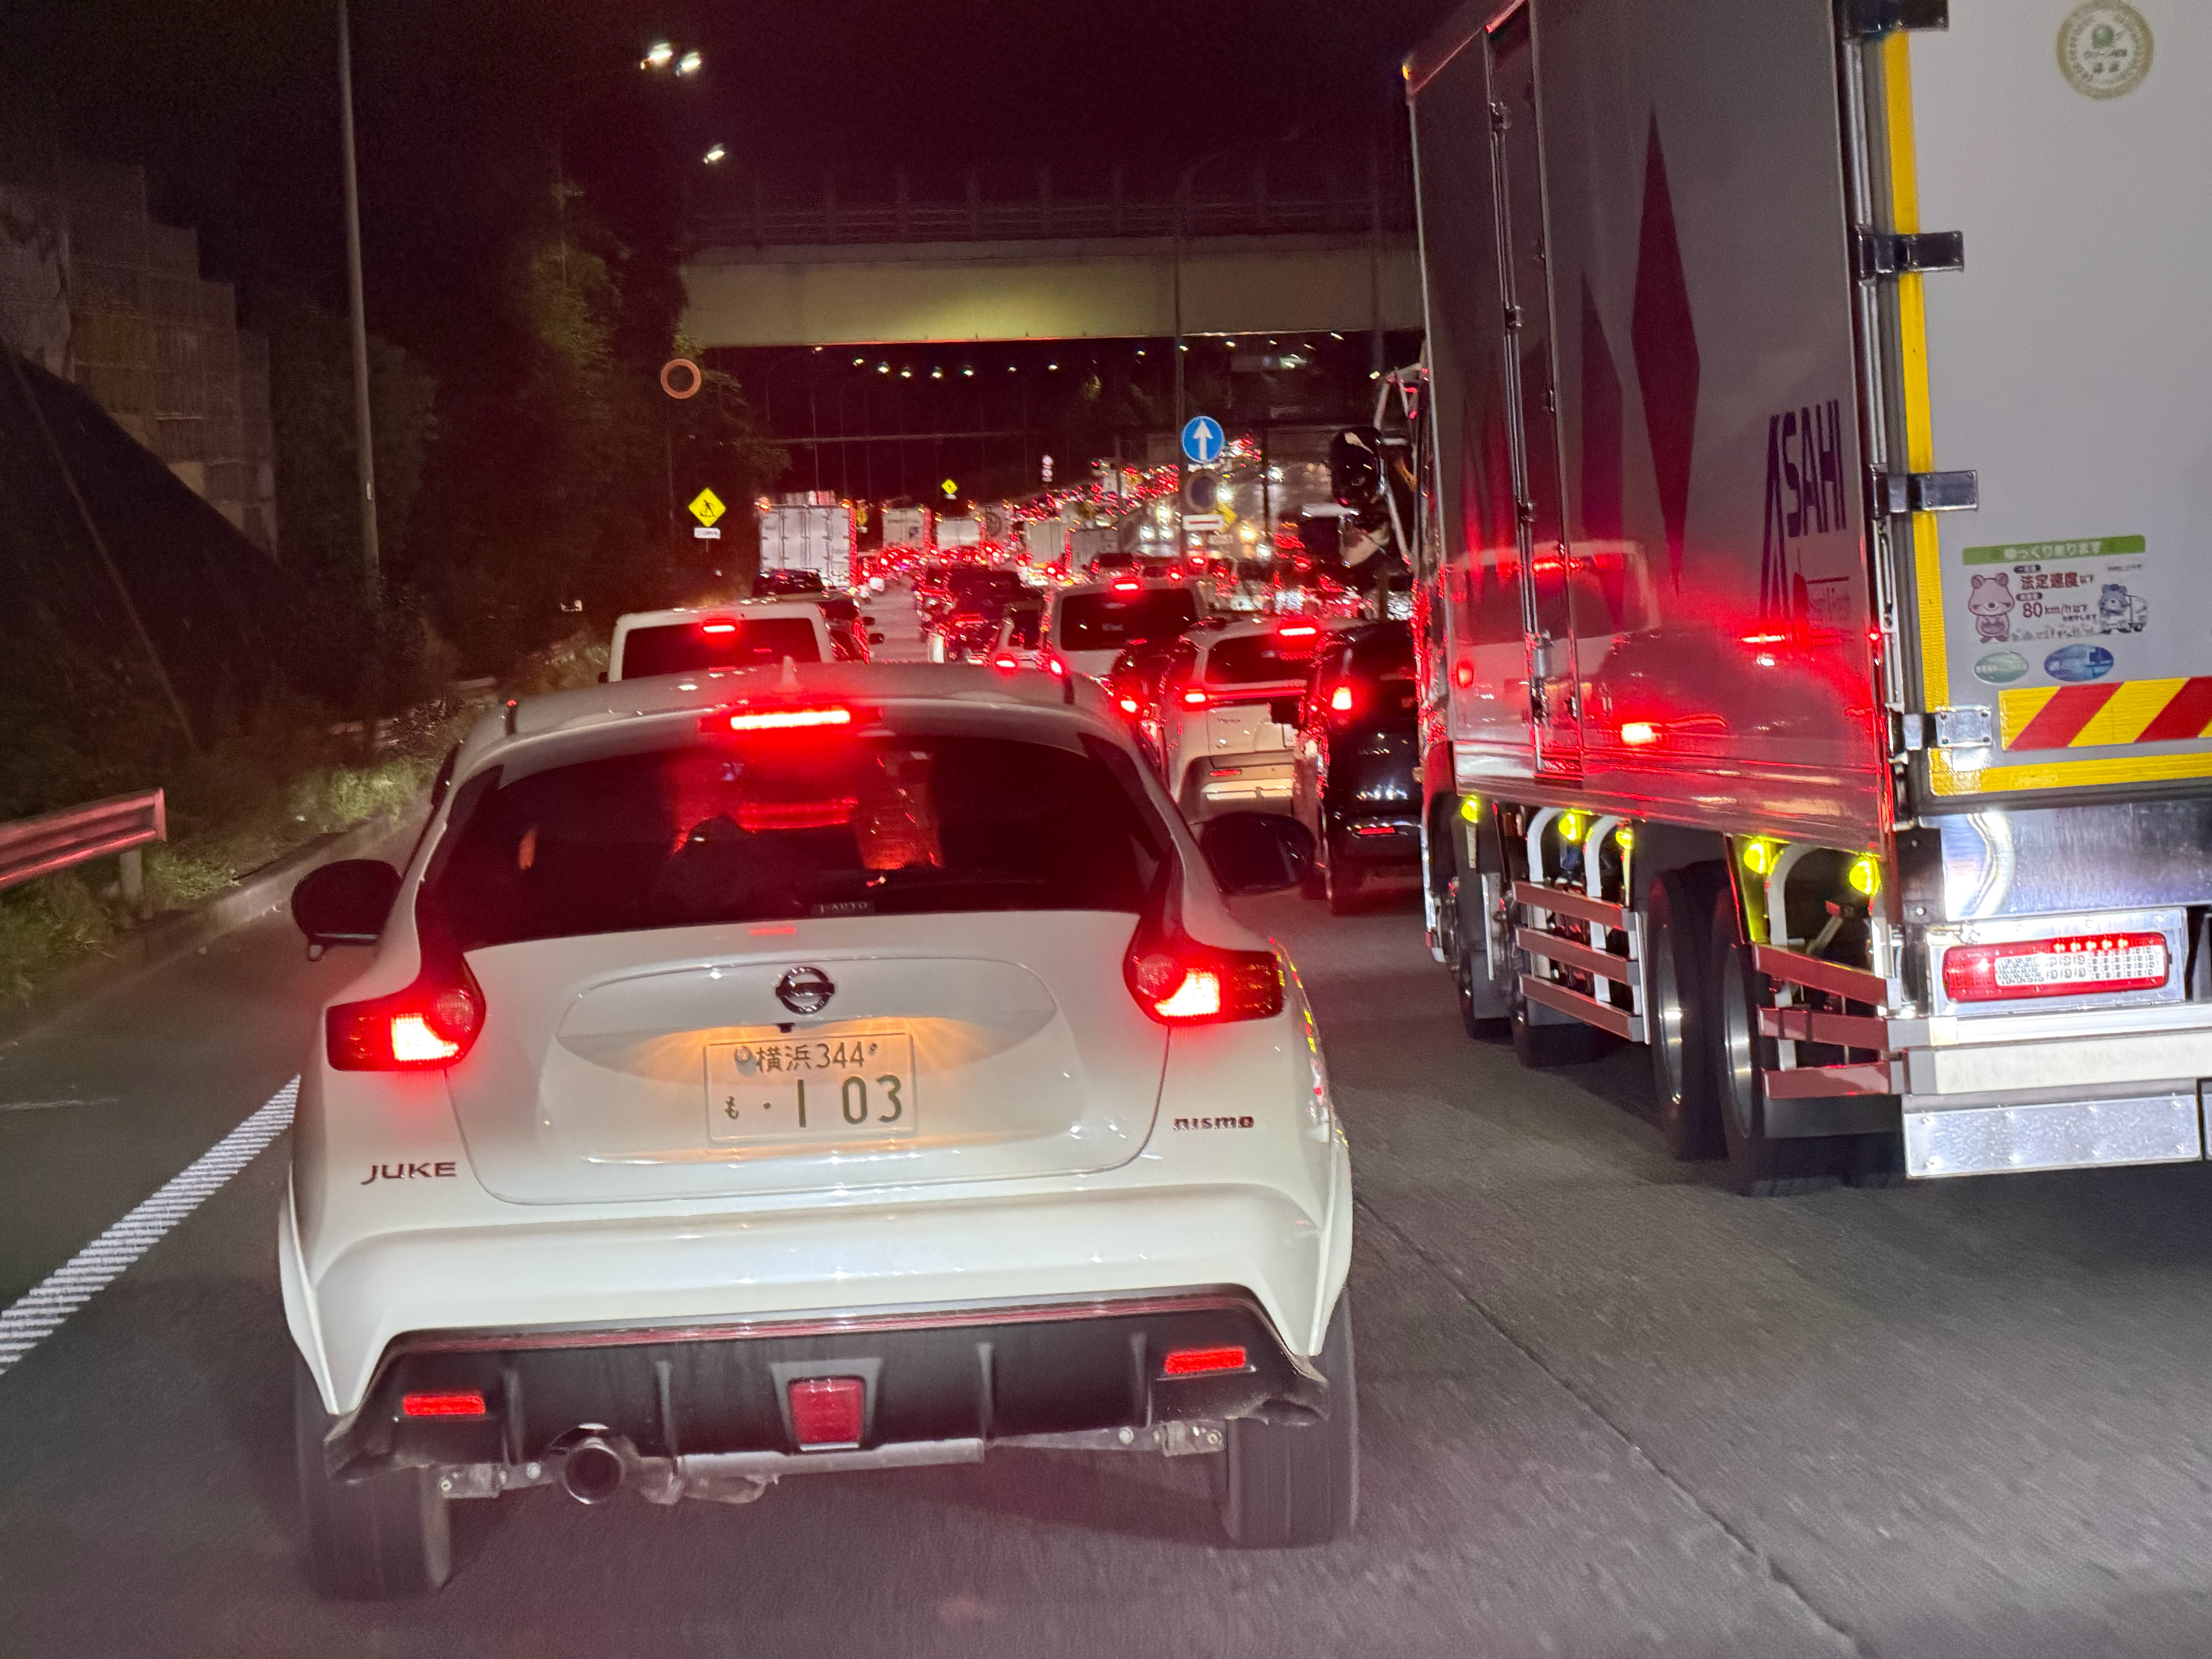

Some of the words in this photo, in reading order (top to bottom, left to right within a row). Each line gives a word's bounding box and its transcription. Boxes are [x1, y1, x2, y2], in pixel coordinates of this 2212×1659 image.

[1759, 399, 1846, 630] ASAHI
[724, 1096, 739, 1120] も
[1173, 1116, 1255, 1131] nismo
[360, 1161, 457, 1185] JUKE
